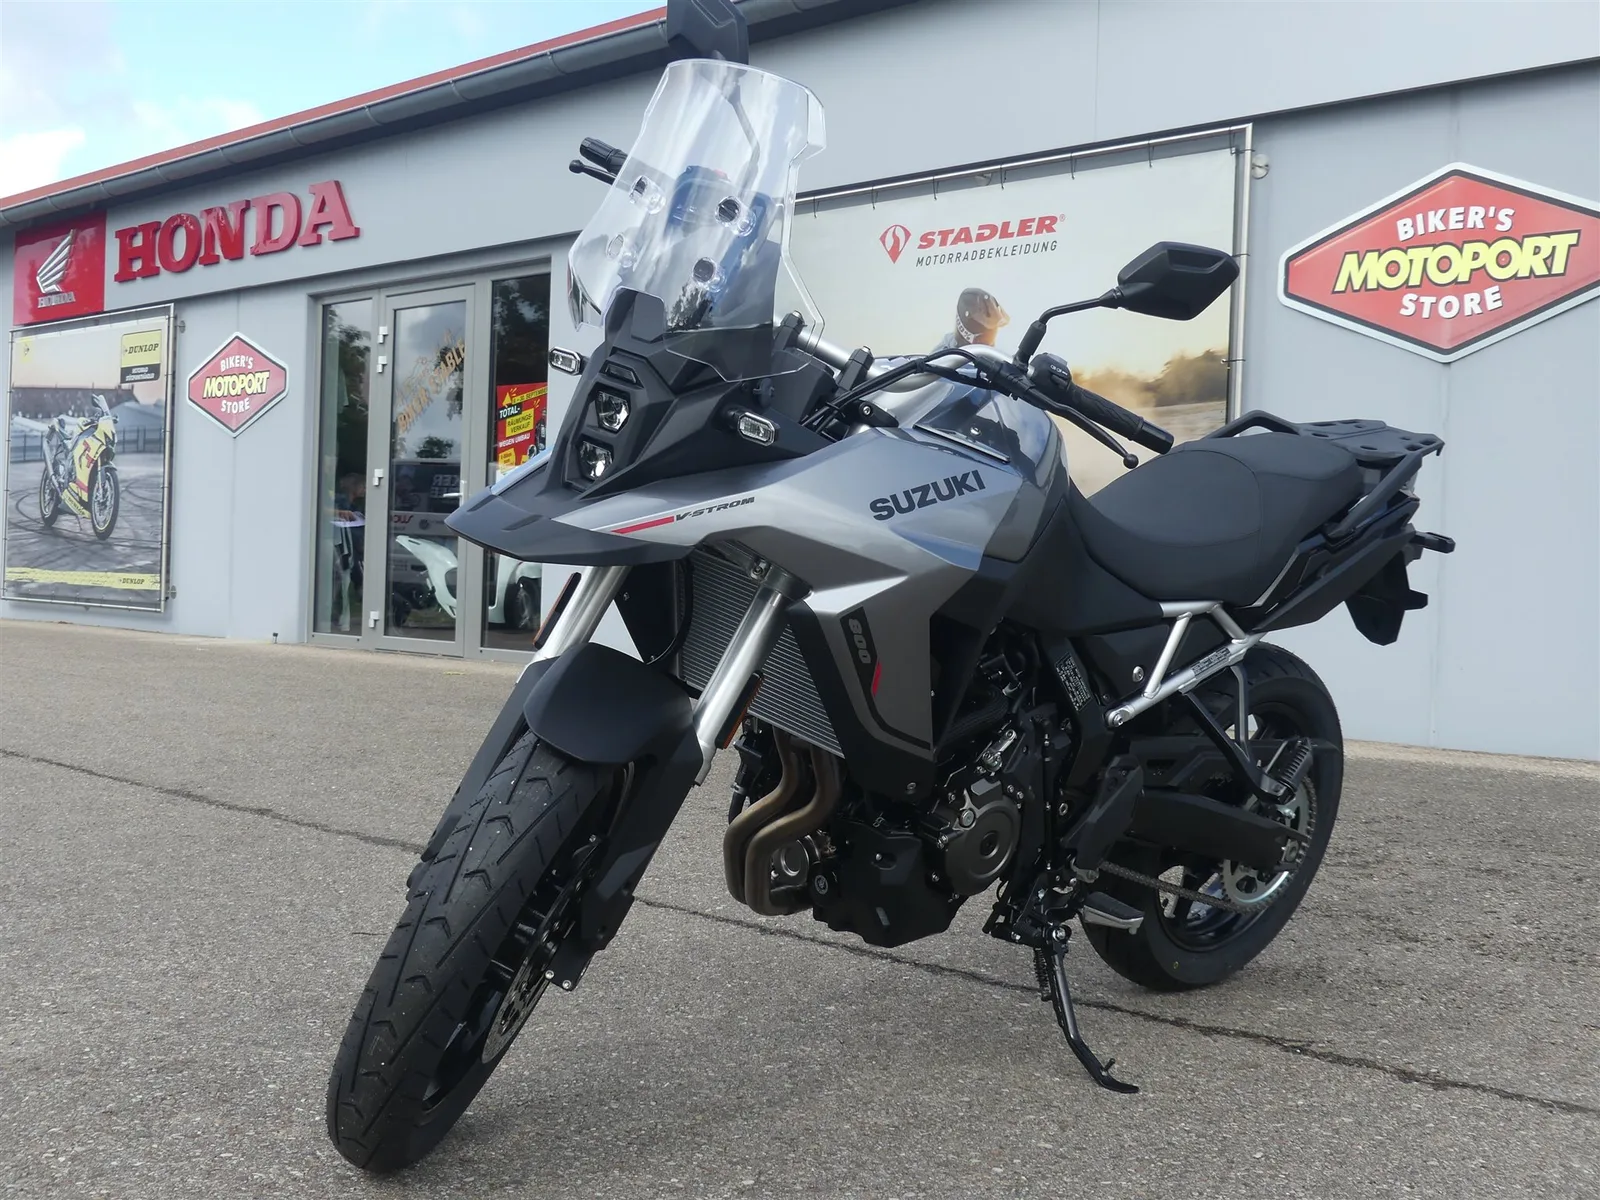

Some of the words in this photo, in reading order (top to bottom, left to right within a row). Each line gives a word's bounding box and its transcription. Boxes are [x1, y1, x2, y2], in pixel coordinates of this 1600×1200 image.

[114, 180, 361, 282] HONDA
[1396, 205, 1516, 242] BIKER'S
[916, 240, 1058, 267] MOTORRADBEKLEIDUNG
[1332, 230, 1581, 294] MOTOPORT
[1399, 286, 1504, 319] STORE
[128, 343, 159, 354] DUNLOP
[220, 355, 254, 372] BIKER'S
[202, 370, 270, 399] MOTOPORT
[220, 398, 251, 414] STORE
[499, 405, 520, 419] TOTAL-
[676, 497, 755, 521] V-STROM
[869, 469, 986, 521] SUZUKI
[848, 618, 872, 664] 800
